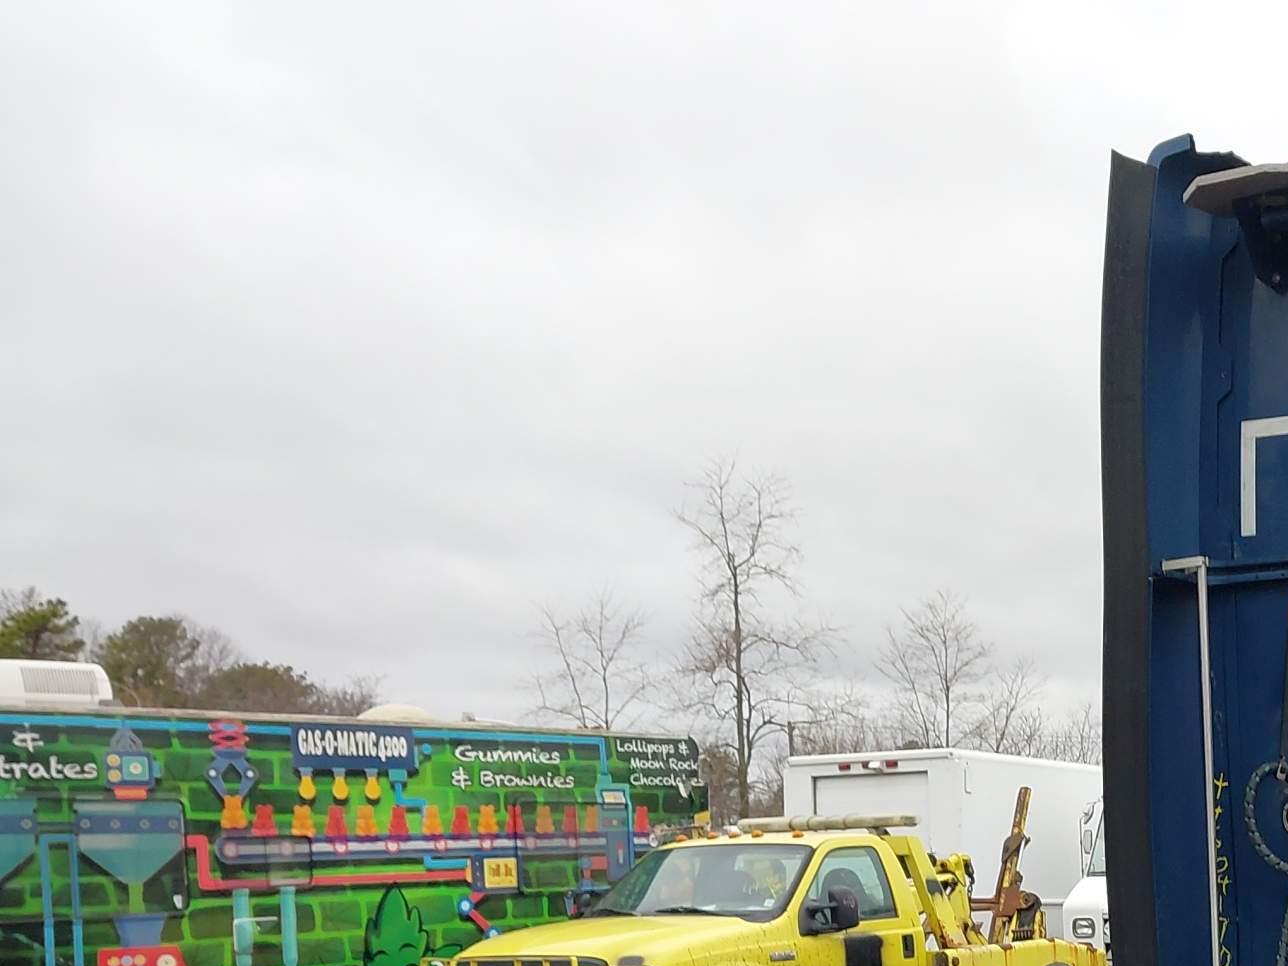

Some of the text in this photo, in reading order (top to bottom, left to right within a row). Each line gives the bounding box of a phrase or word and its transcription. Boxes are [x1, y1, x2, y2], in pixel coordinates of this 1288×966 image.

[378, 735, 408, 762] 4200
[454, 744, 561, 764] Gummies
[616, 739, 675, 760] Lollipops
[630, 757, 665, 770] Moon
[451, 766, 575, 790] & Brownies
